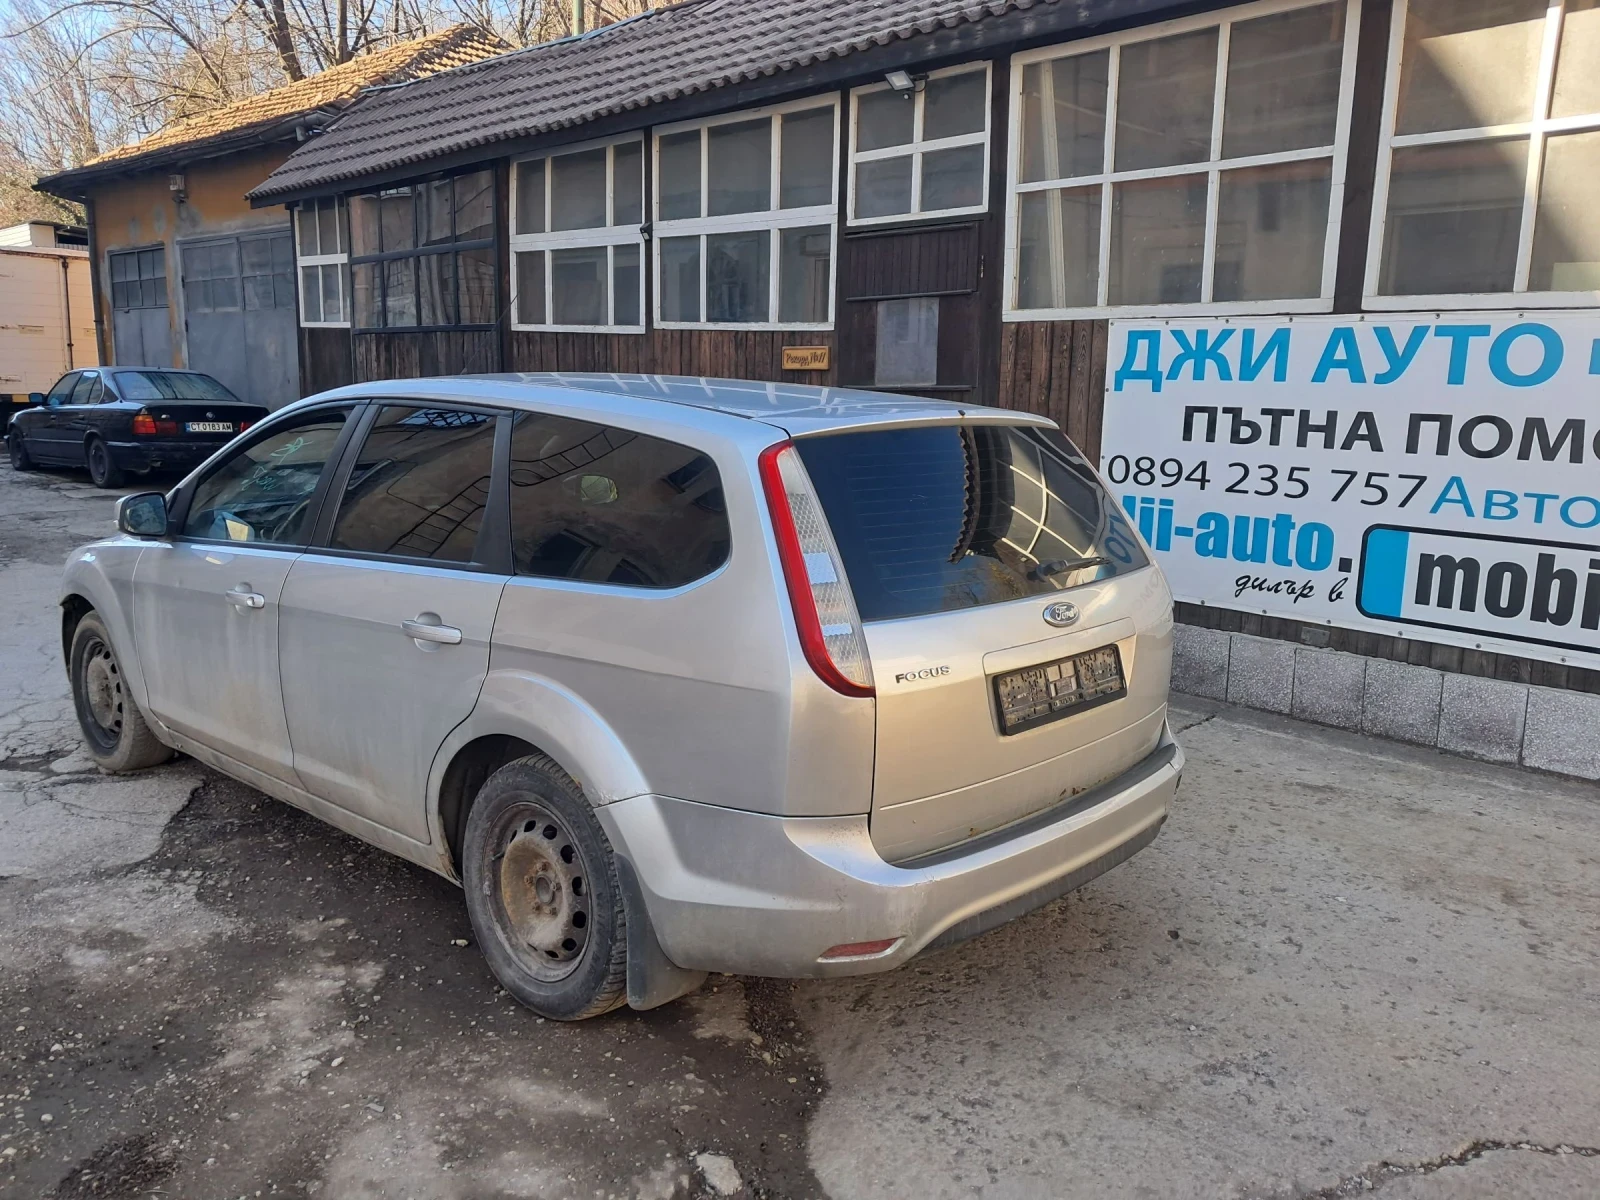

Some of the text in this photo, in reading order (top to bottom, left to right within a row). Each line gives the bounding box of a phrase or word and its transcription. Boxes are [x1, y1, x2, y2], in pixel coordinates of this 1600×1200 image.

[1114, 322, 1564, 392] ДЖИ АУТО
[1182, 406, 1384, 452] ПЪТНА
[1108, 455, 1428, 508] 0894 235 757
[1234, 574, 1315, 604] дилър
[895, 664, 951, 684] FOCUS
